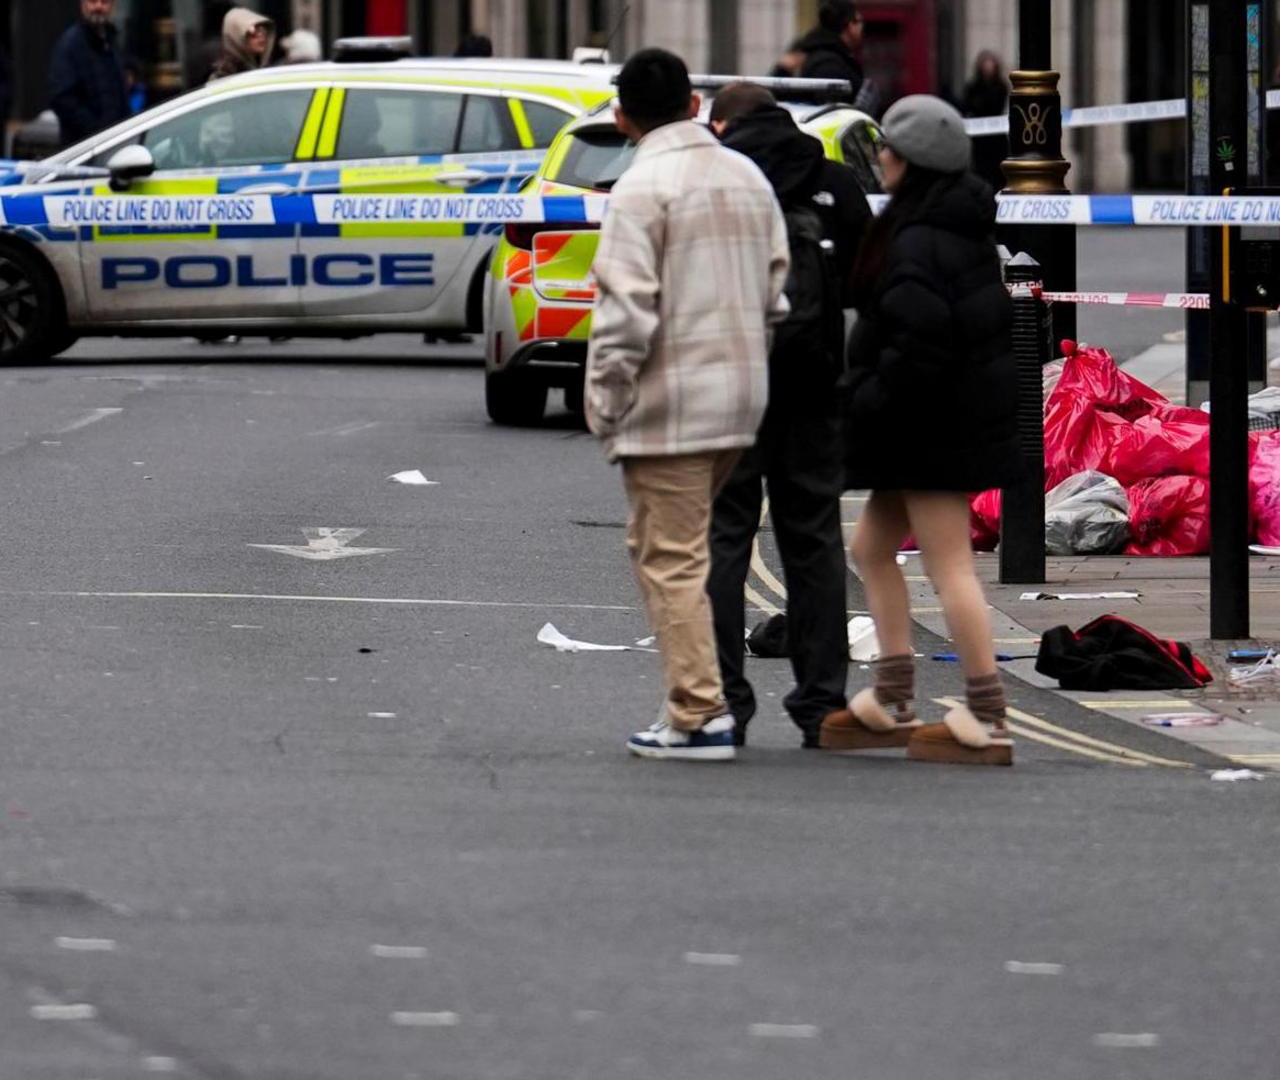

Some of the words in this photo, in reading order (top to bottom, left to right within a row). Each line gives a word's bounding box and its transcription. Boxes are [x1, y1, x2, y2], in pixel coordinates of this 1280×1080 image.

[63, 200, 113, 220] POLICE
[116, 200, 149, 220] LINE
[151, 200, 170, 220] DO
[175, 200, 204, 220] NOT
[207, 200, 255, 220] CROSS
[332, 198, 383, 219] POLICE
[385, 198, 417, 219] LINE
[419, 198, 441, 219] DO
[445, 198, 474, 219] NOT
[476, 198, 524, 219] CROSS
[1020, 200, 1071, 219] CROSS
[1150, 200, 1202, 221] POLICE
[1205, 200, 1237, 221] LINE
[1241, 200, 1263, 221] DO
[101, 253, 435, 290] POLICE
